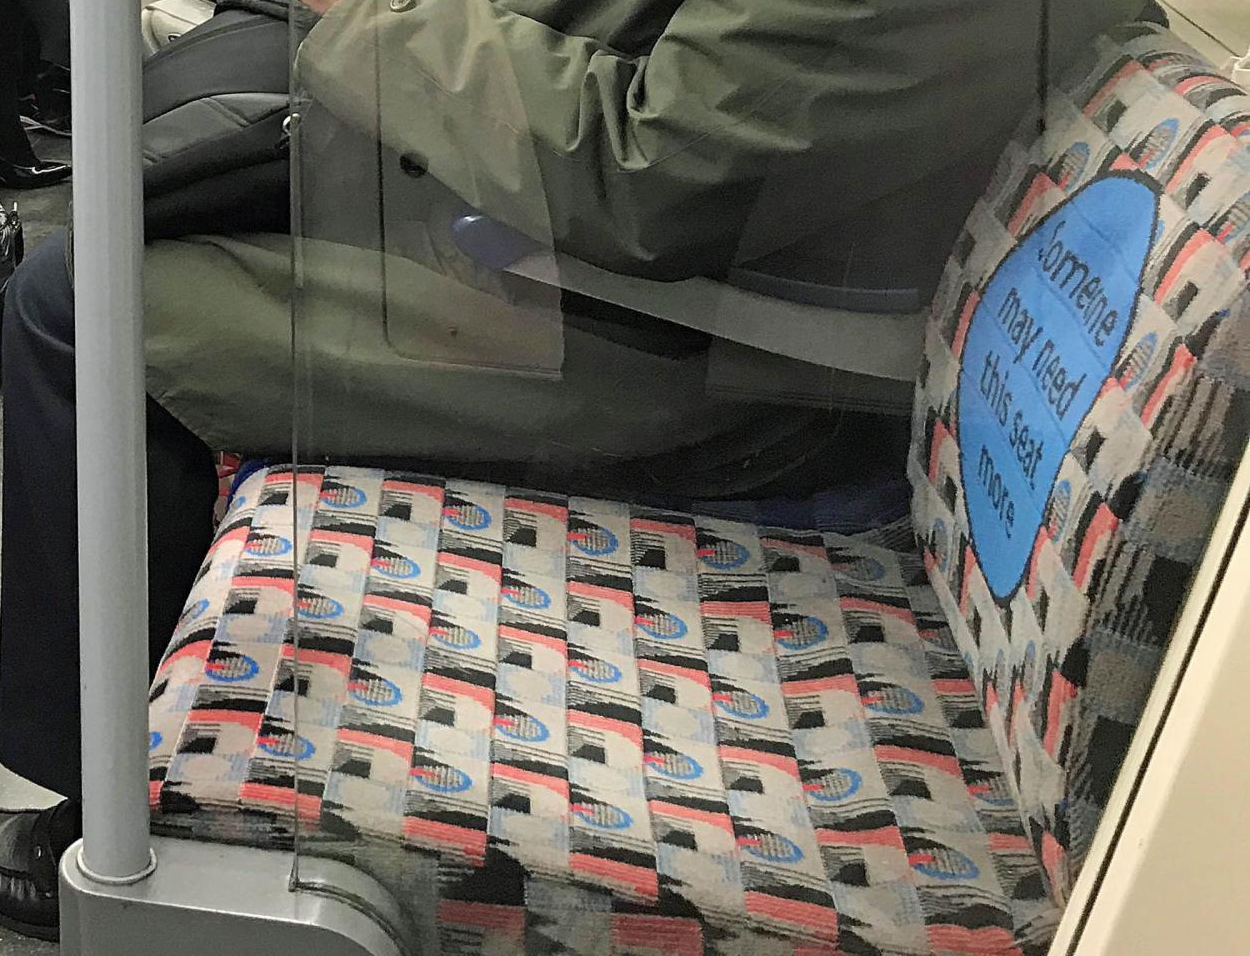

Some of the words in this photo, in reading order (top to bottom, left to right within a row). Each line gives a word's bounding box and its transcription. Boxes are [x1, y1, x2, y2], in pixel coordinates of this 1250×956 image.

[979, 349, 1013, 428] this
[1009, 409, 1044, 491] seat
[998, 287, 1043, 364] may
[1032, 339, 1087, 421] need
[977, 444, 1016, 539] more
